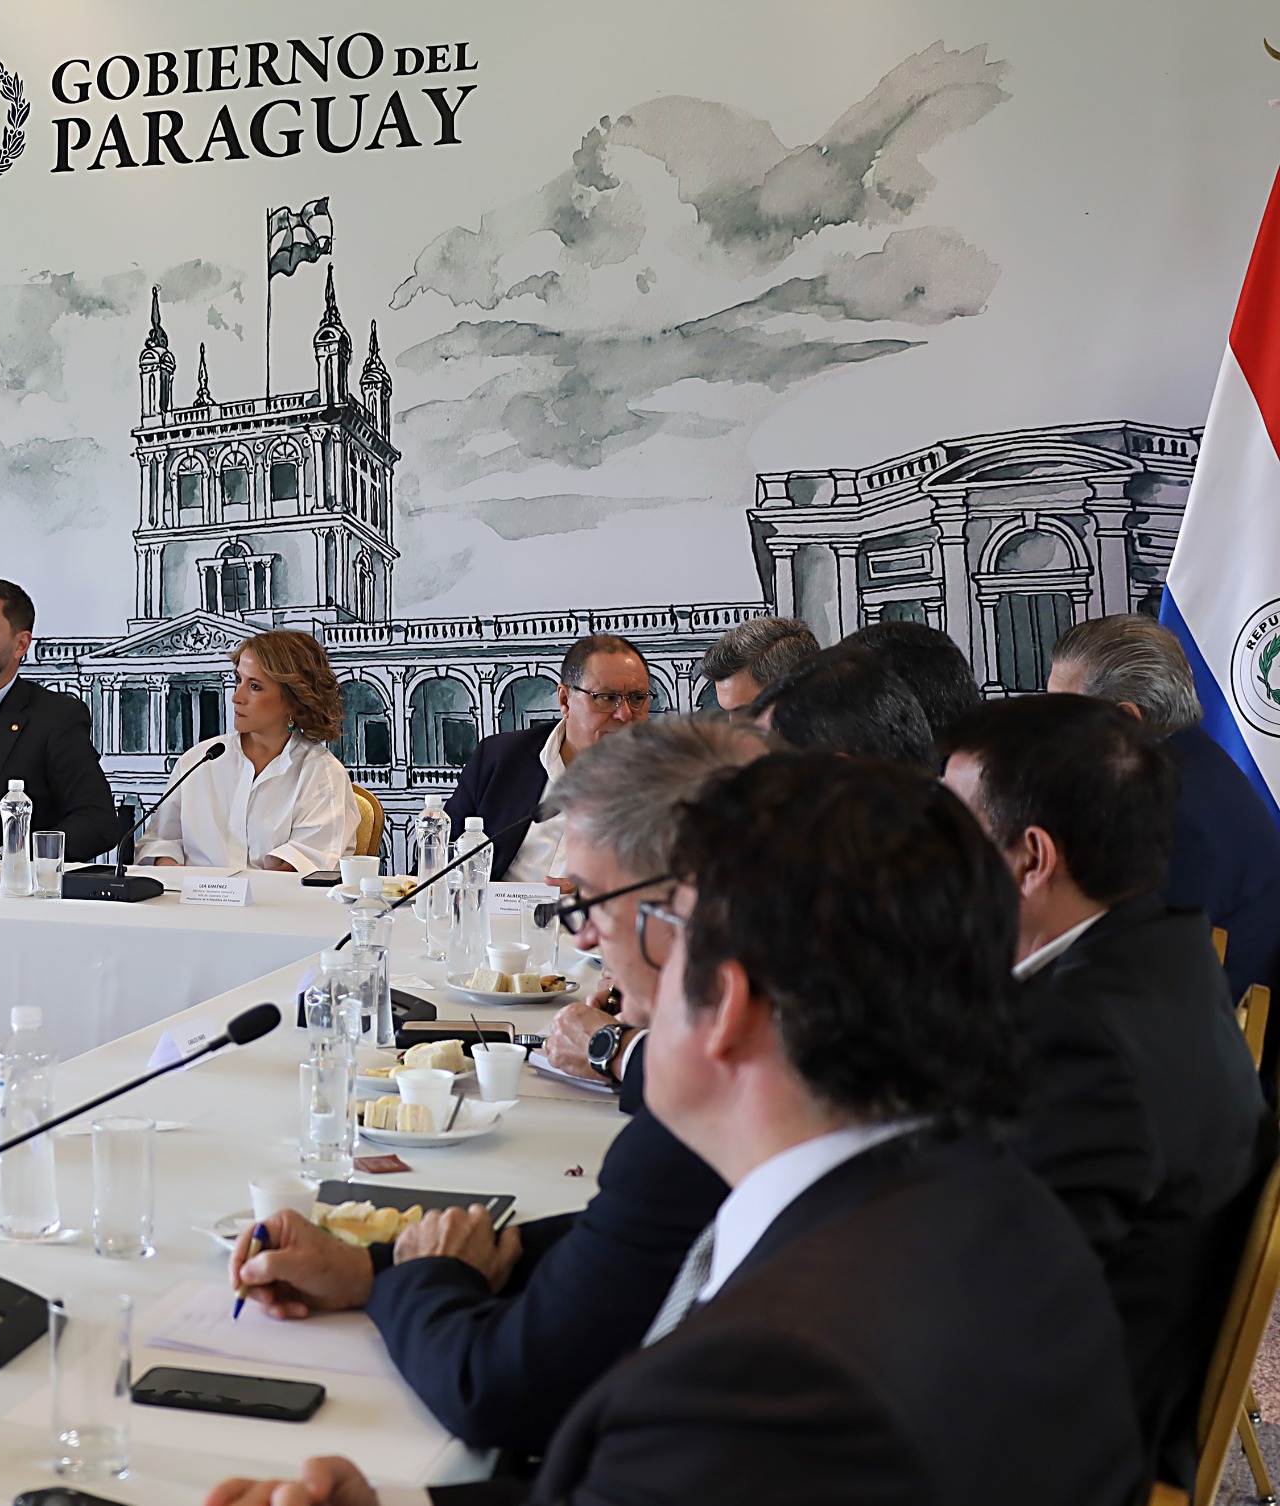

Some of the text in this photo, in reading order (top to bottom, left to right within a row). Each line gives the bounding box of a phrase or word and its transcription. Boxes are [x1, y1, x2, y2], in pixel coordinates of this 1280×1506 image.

[52, 32, 479, 105] GOBIERNO DEL
[50, 85, 478, 173] PARAGUAY
